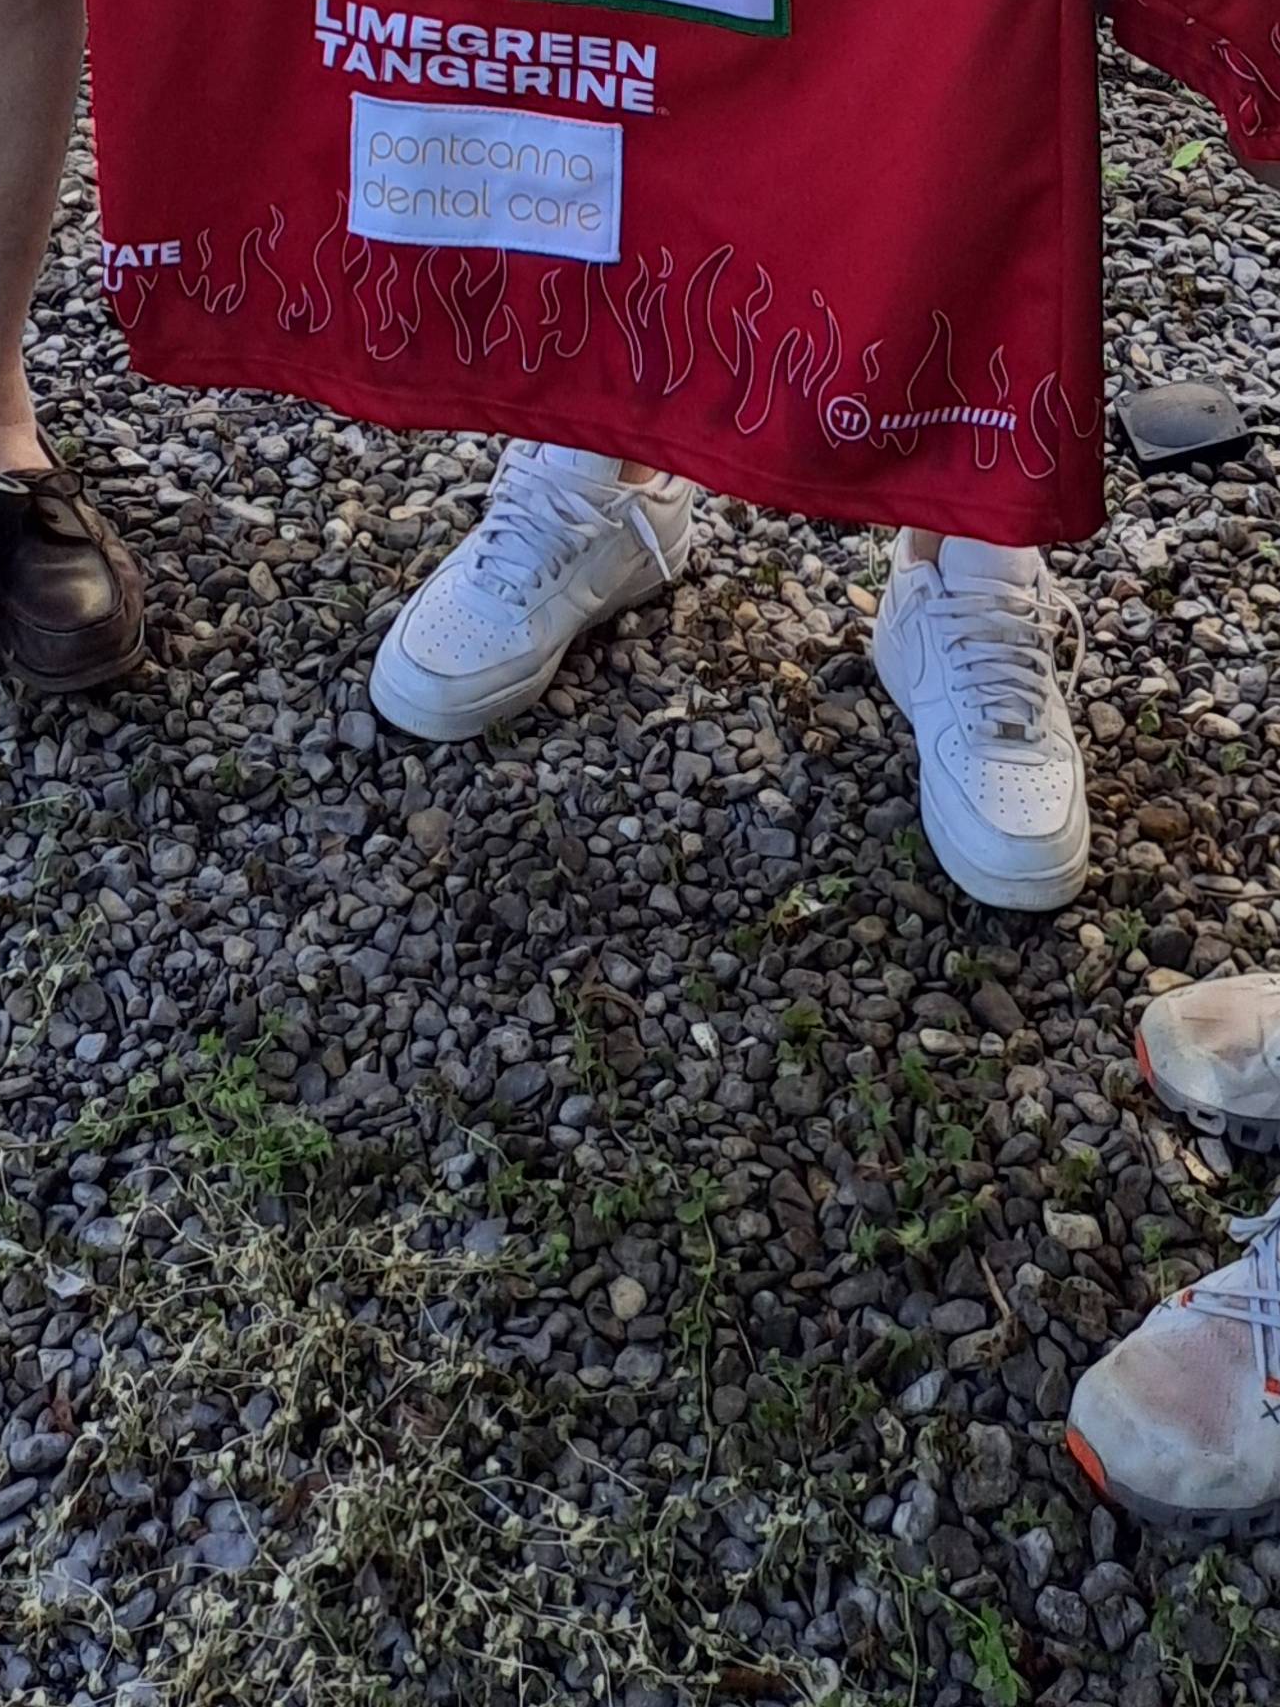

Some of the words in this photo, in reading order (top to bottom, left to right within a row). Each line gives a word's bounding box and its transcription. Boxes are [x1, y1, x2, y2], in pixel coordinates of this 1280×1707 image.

[313, 28, 657, 115] TANGERINE
[367, 128, 594, 182] pontcanna
[361, 178, 490, 219] dental
[507, 189, 602, 232] care
